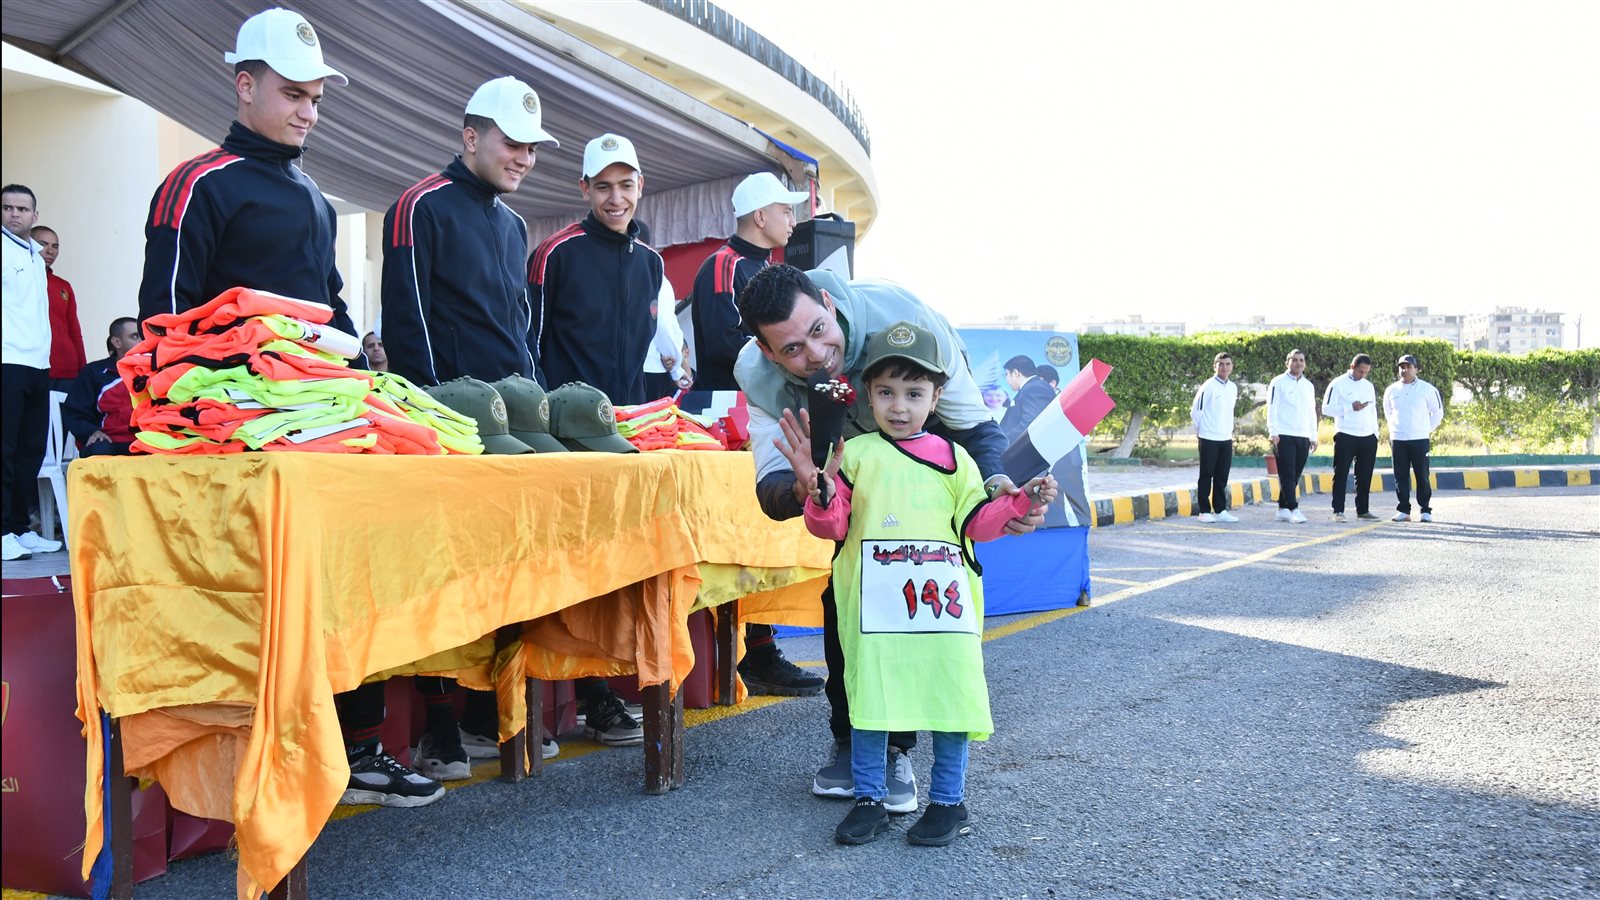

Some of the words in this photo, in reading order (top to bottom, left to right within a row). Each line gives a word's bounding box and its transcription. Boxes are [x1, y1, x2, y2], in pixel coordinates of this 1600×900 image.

[787, 244, 808, 256] MIPRO
[873, 545, 908, 565] المصرية
[902, 578, 964, 620] ١٩٤
